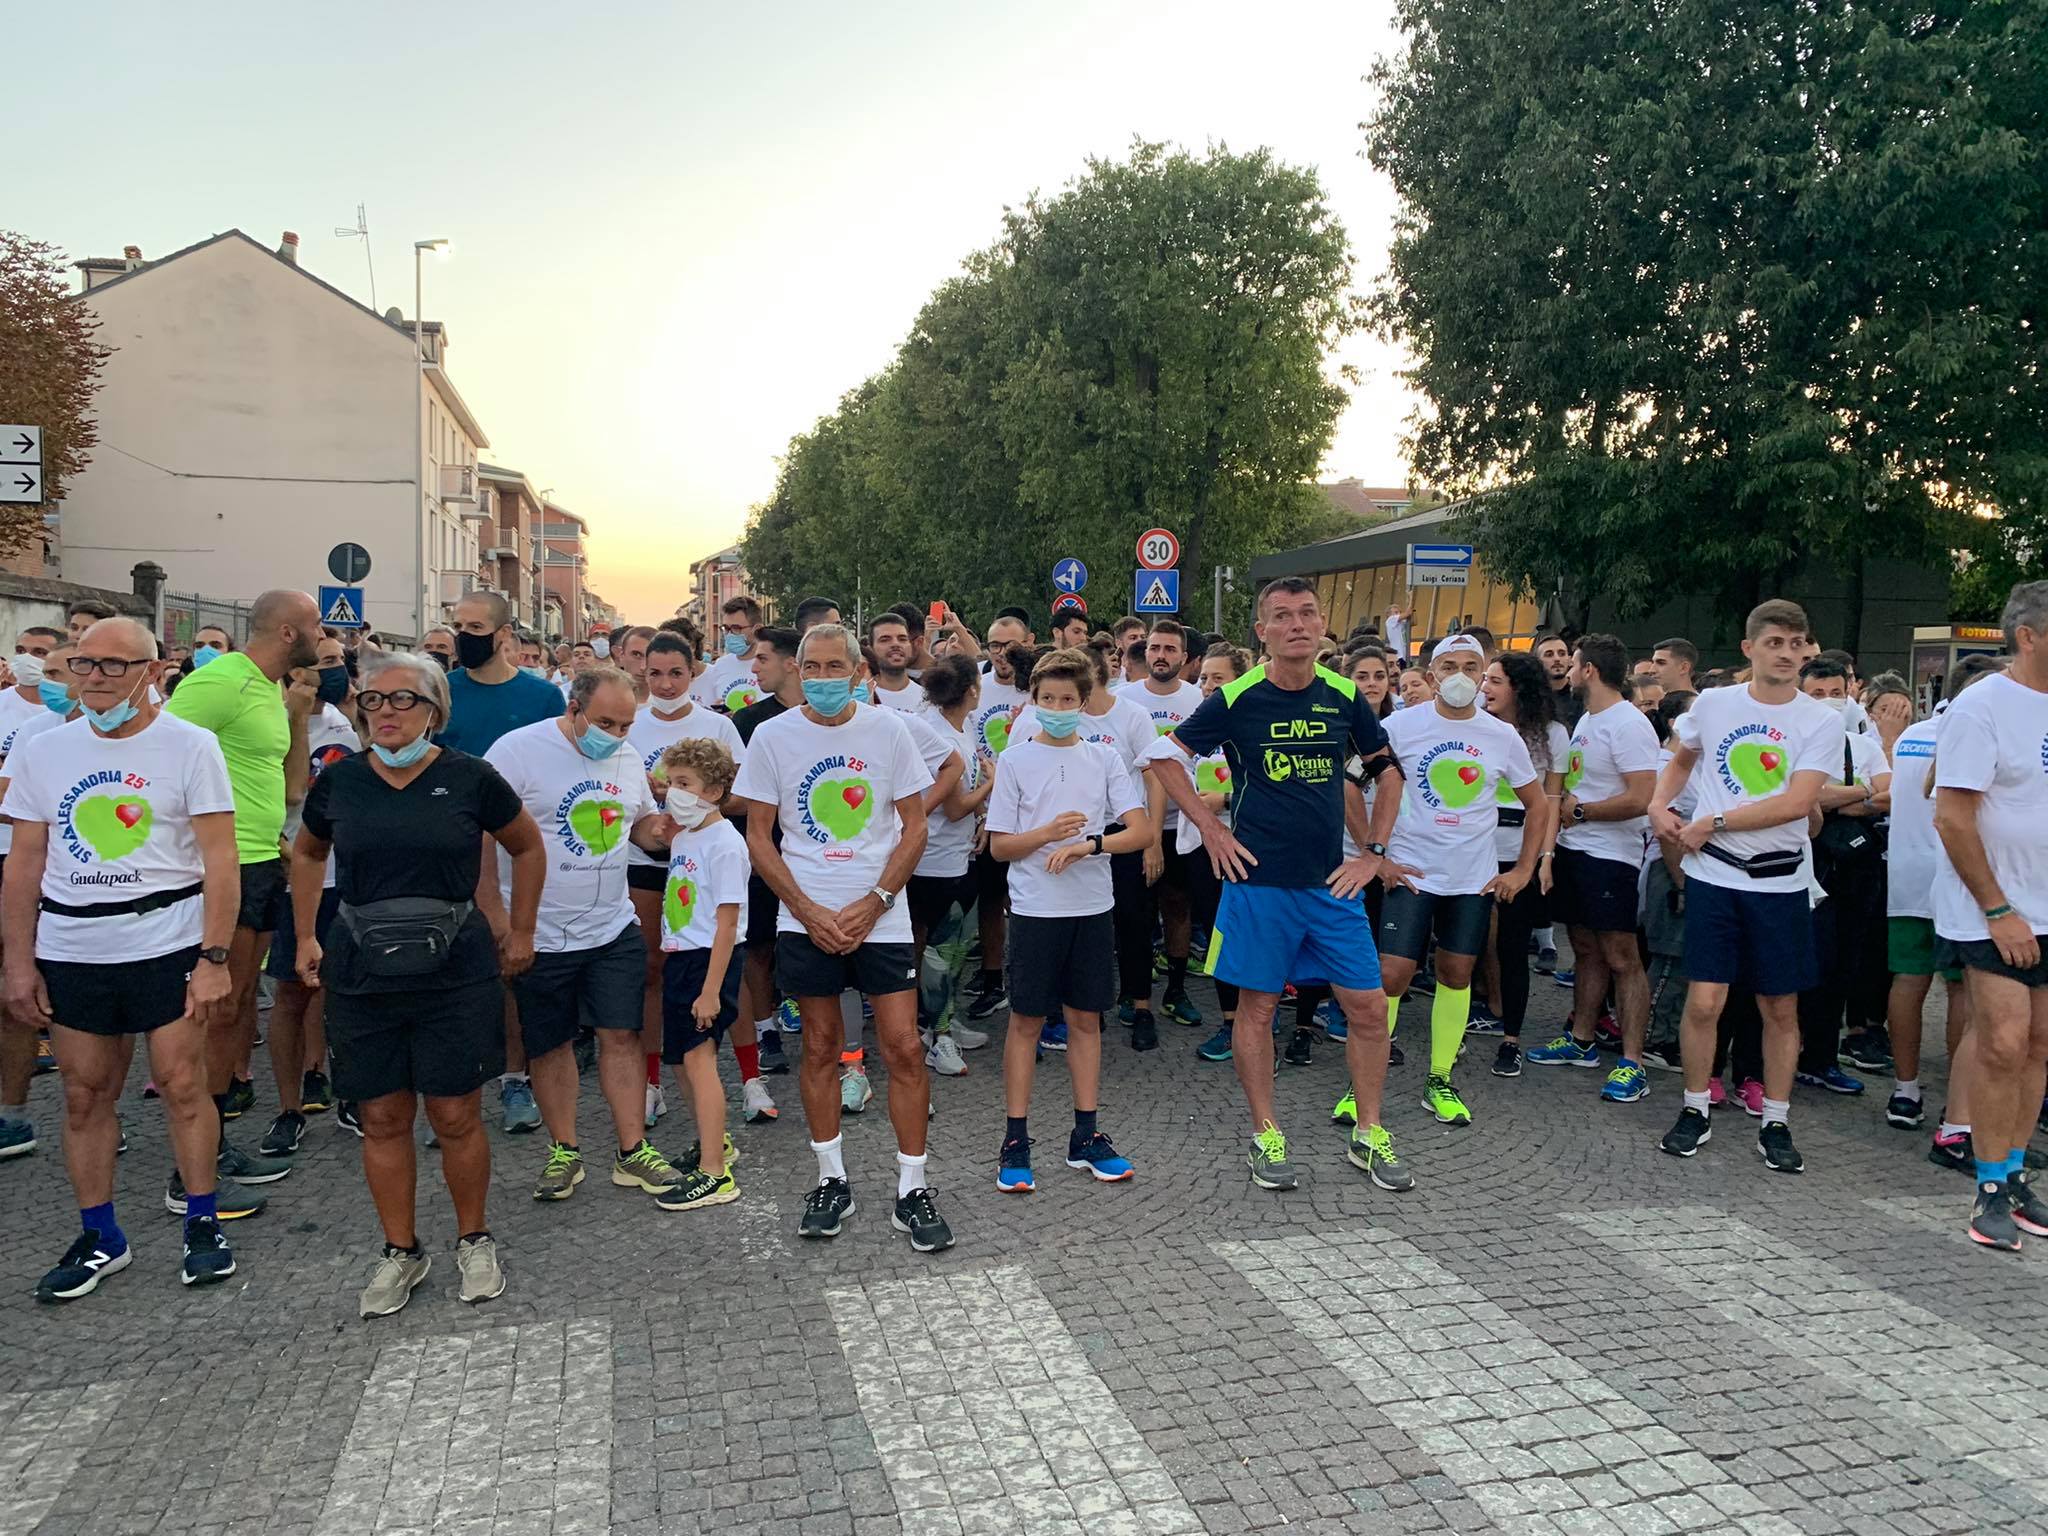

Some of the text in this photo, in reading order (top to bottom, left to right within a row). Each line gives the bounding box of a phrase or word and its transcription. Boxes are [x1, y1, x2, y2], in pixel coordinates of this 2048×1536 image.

[1147, 541, 1170, 560] 30
[1422, 574, 1465, 584] Luigi Ceriana
[1960, 627, 2004, 638] FOTOTES
[1270, 720, 1327, 738] CMP
[1290, 754, 1334, 770] Venice
[70, 869, 143, 887] Gualapack
